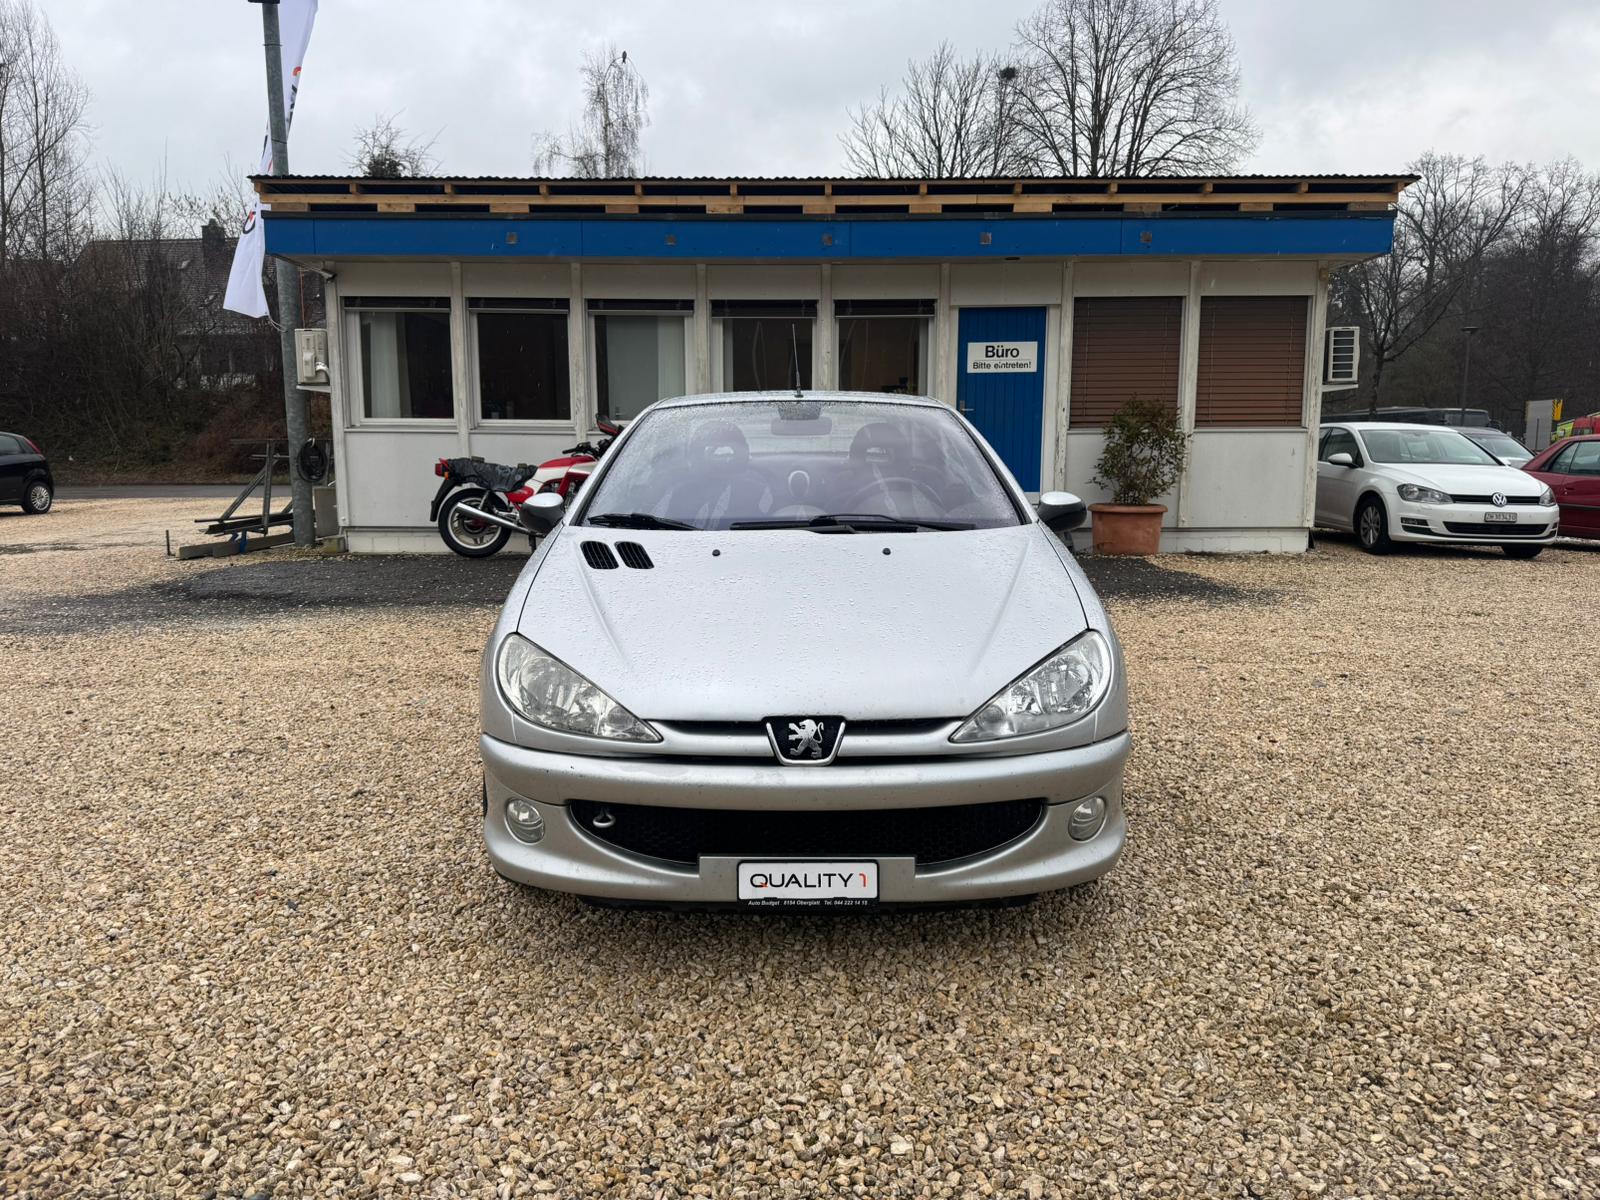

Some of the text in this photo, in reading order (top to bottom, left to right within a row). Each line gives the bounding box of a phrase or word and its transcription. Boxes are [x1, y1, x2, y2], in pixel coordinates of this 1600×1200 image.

[985, 345, 1020, 358] Büro
[972, 361, 1032, 370] Bitte eintreten!
[750, 873, 868, 888] QUALITY 1
